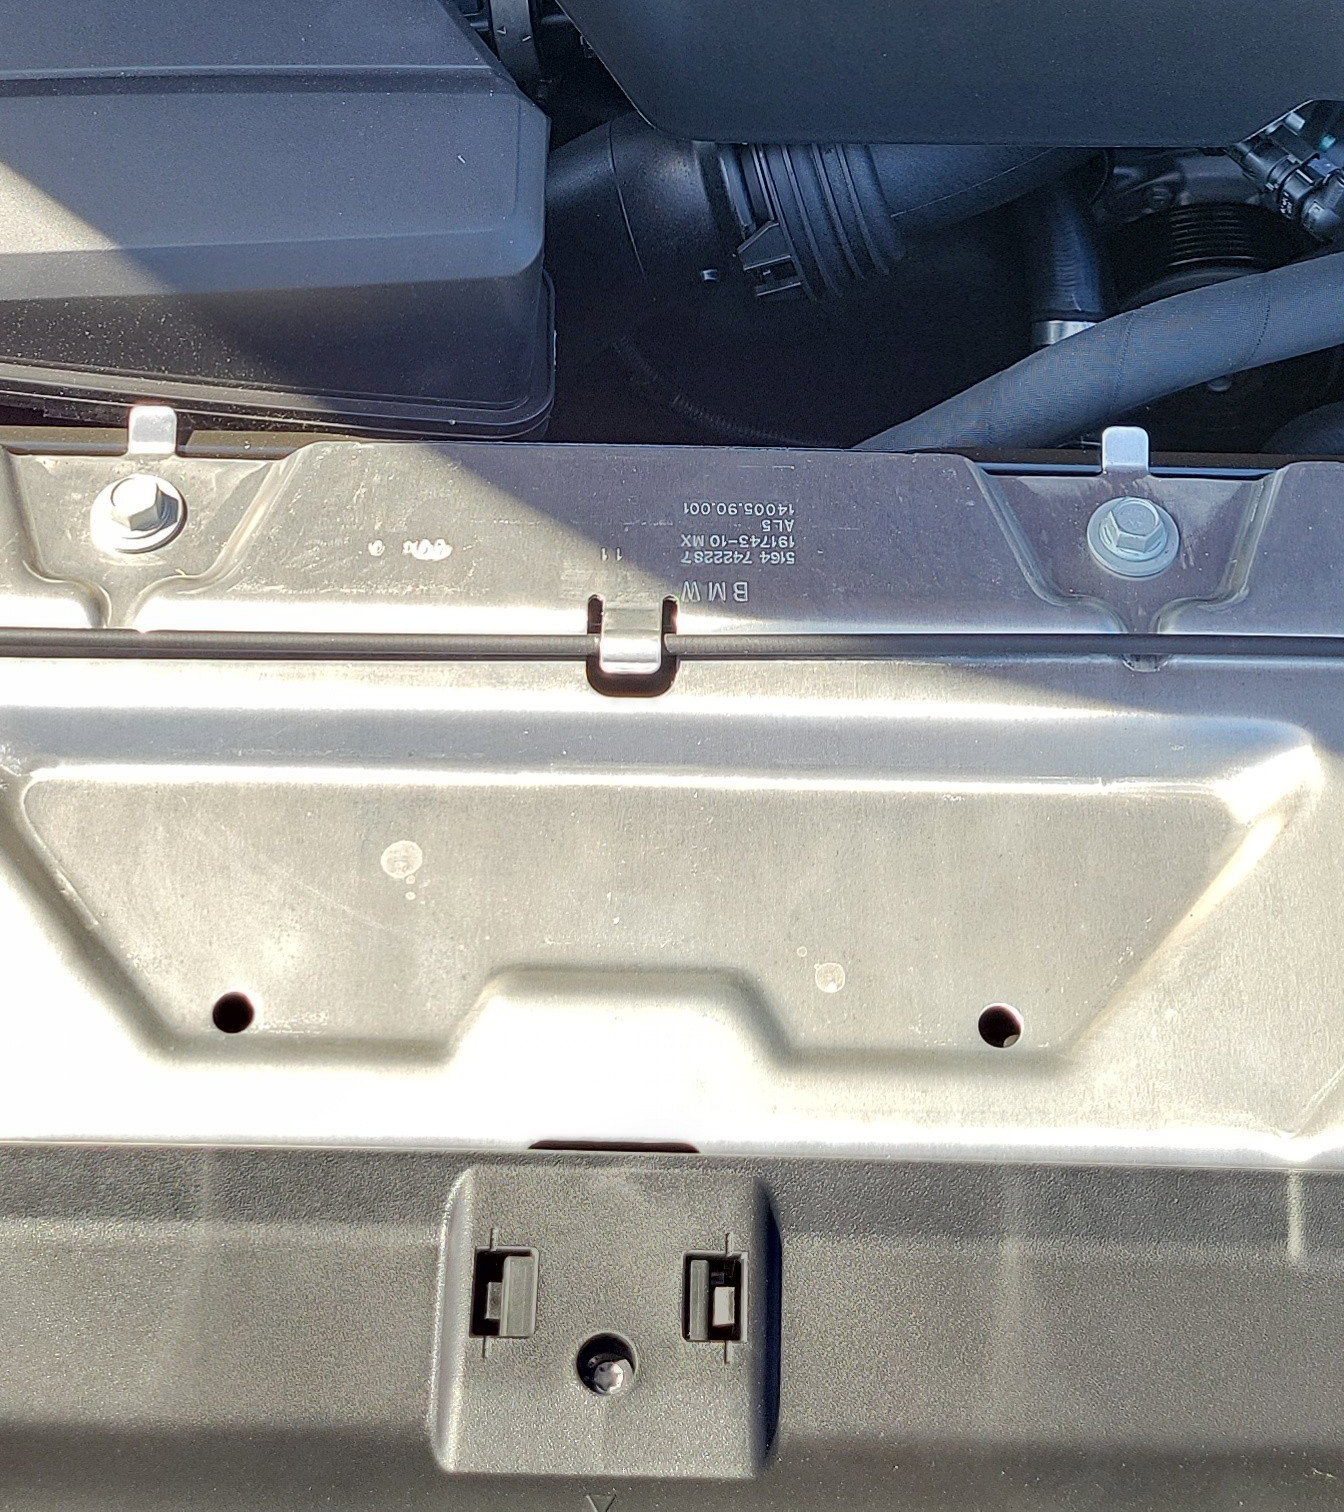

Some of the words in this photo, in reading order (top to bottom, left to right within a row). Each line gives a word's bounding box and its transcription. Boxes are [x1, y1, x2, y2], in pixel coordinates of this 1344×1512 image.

[682, 502, 796, 516] 14005.90.001
[761, 519, 796, 532] AL5
[680, 534, 705, 547] MX
[709, 535, 796, 548] 191743-10
[759, 550, 796, 564] 5164
[681, 580, 749, 602] BMW
